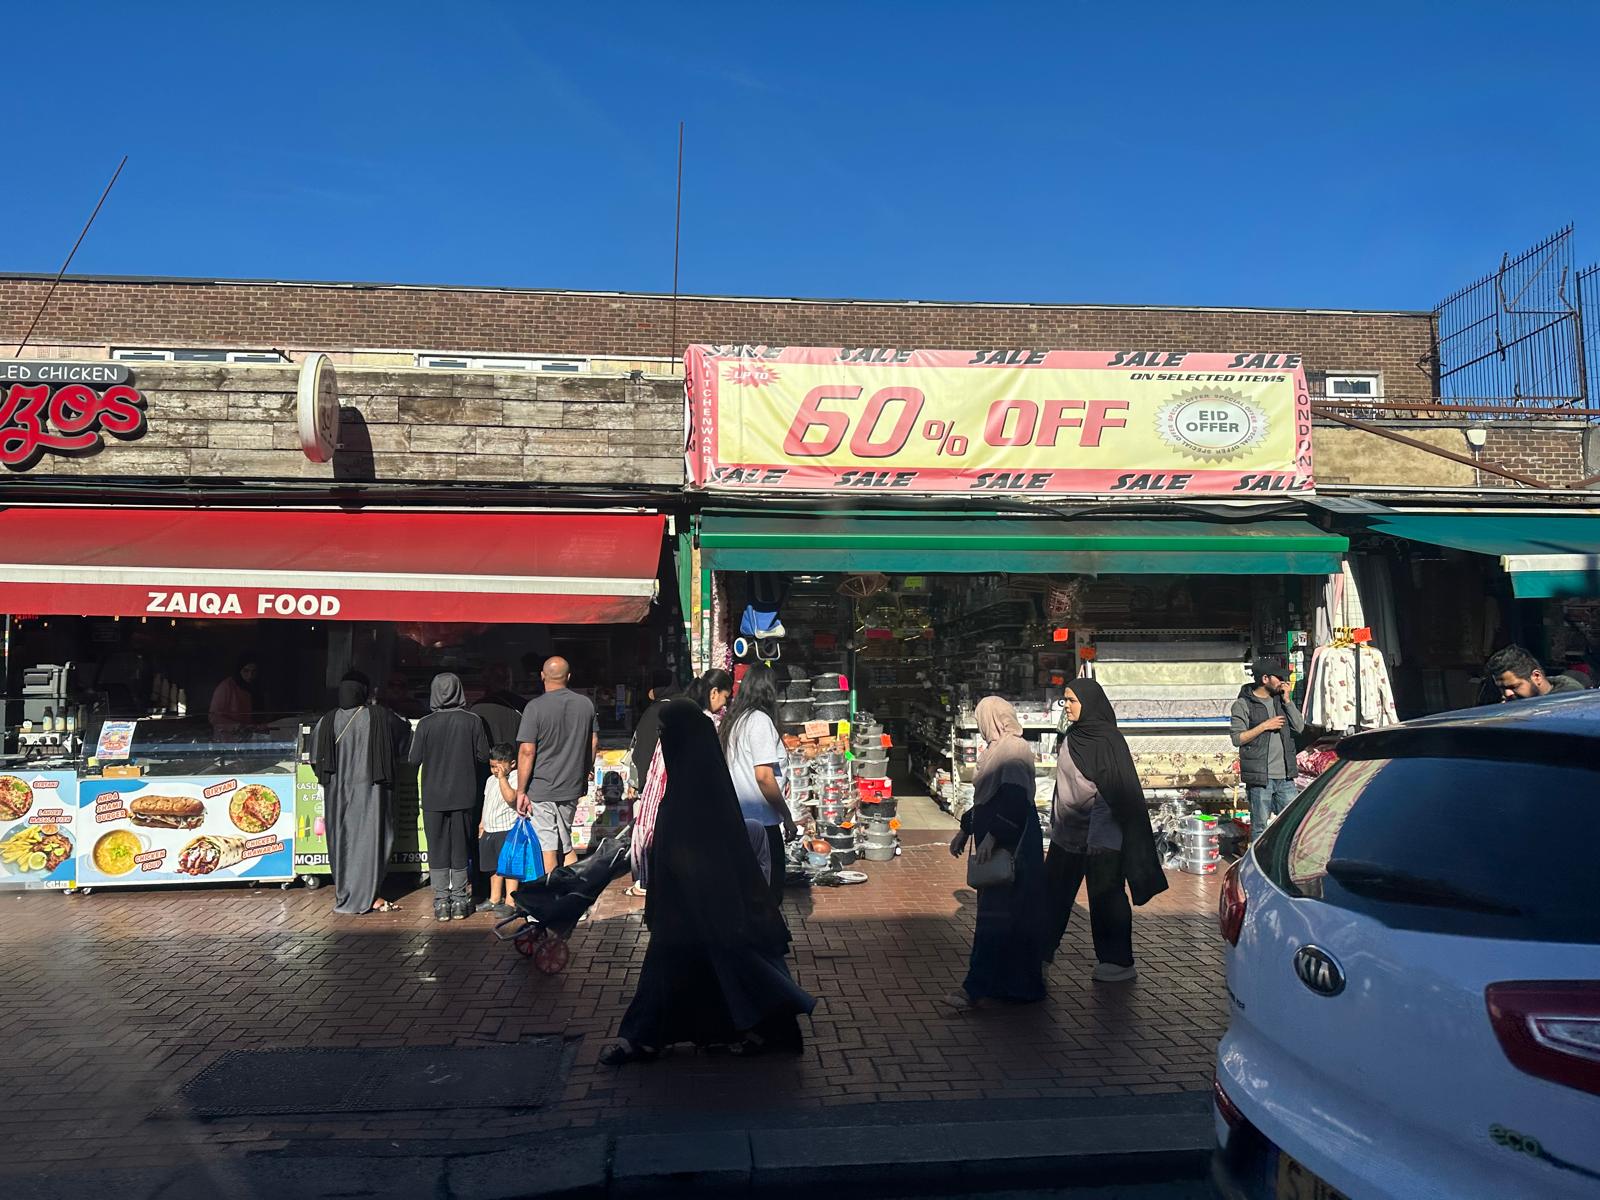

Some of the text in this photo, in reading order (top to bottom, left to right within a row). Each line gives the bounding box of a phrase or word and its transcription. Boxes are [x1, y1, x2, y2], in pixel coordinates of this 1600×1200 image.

[834, 347, 916, 363] SALE
[968, 349, 1049, 365] SALE
[1107, 351, 1190, 367] SALE
[1227, 353, 1302, 369] SALE
[0, 365, 118, 380] ED CHICKEN
[734, 370, 769, 380] UP TO
[1130, 373, 1286, 383] ON SELECTED ITEMS
[1198, 410, 1229, 421] EID
[984, 399, 1130, 447] OFF
[1186, 422, 1240, 433] OFFER
[1297, 379, 1312, 467] LONDON
[704, 468, 789, 484] SALE
[834, 470, 918, 487] SALE
[969, 472, 1055, 489] SALE
[1110, 474, 1193, 490] SALE
[146, 591, 341, 616] ZAIQA FOOD
[204, 780, 237, 799] BIRYANI
[97, 792, 119, 804] ANDA
[96, 801, 123, 814] SHAMI
[96, 810, 127, 823] BURGER
[246, 836, 276, 849] CHICKEN
[134, 850, 166, 864] CHICKEN
[242, 844, 284, 859] SHAWARMA
[295, 854, 331, 865] MOBIL
[142, 861, 162, 872] SOUP
[1298, 951, 1334, 990] KIA
